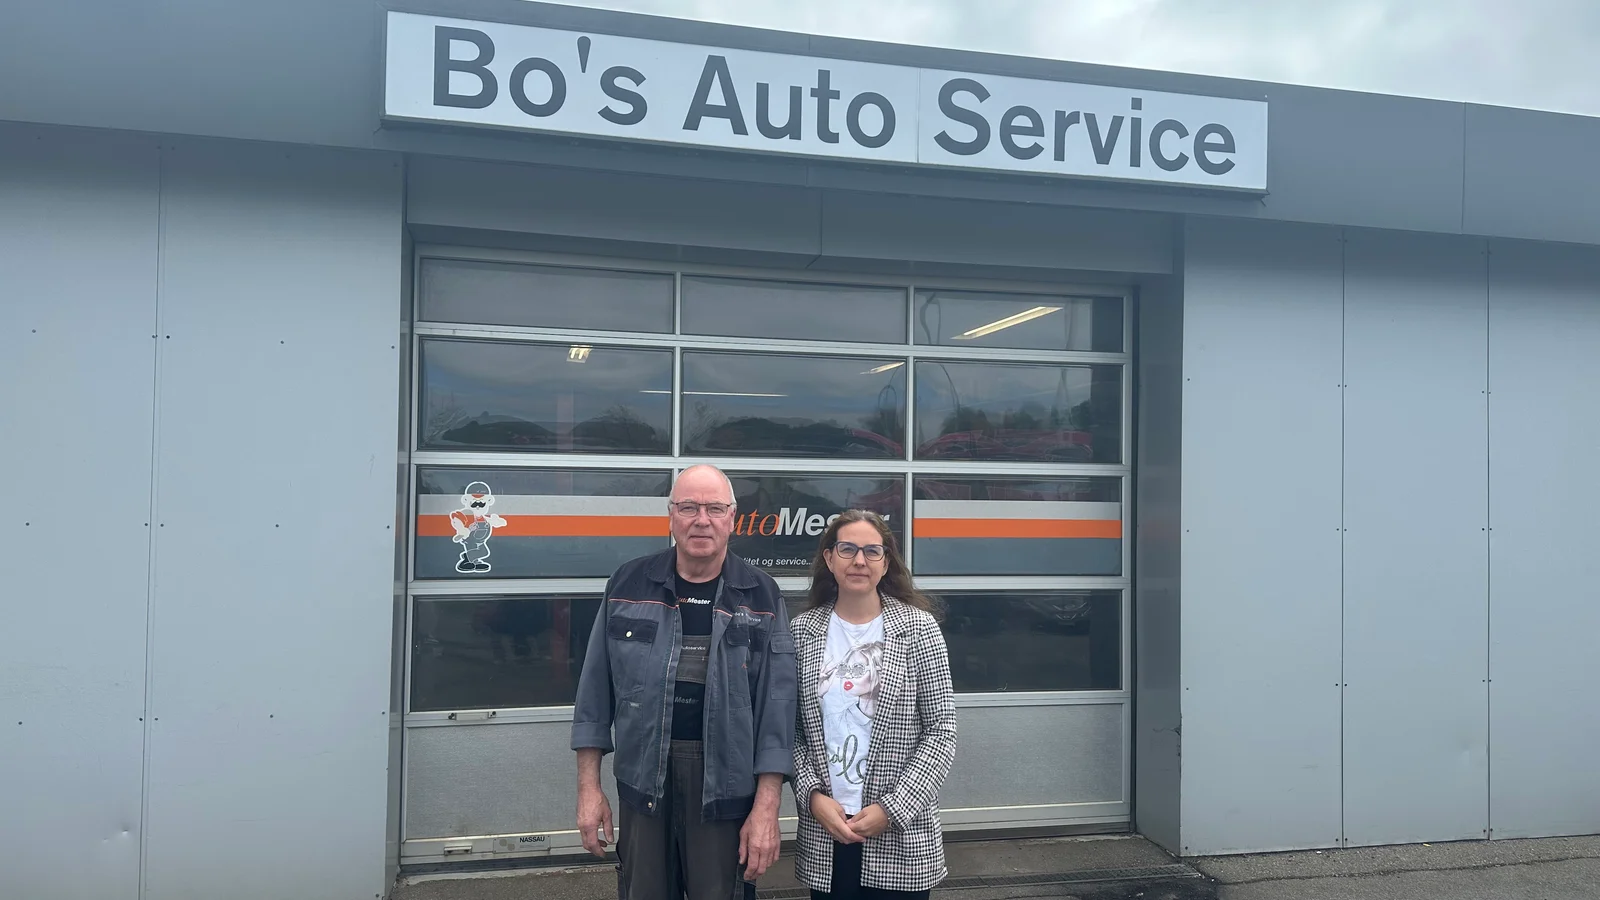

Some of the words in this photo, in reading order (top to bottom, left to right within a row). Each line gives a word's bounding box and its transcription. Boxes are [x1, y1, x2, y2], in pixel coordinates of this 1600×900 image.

[433, 25, 648, 126] Bo's
[682, 54, 896, 149] Auto
[933, 77, 1236, 176] Service
[761, 558, 774, 567] og
[519, 835, 545, 843] NASSAU
